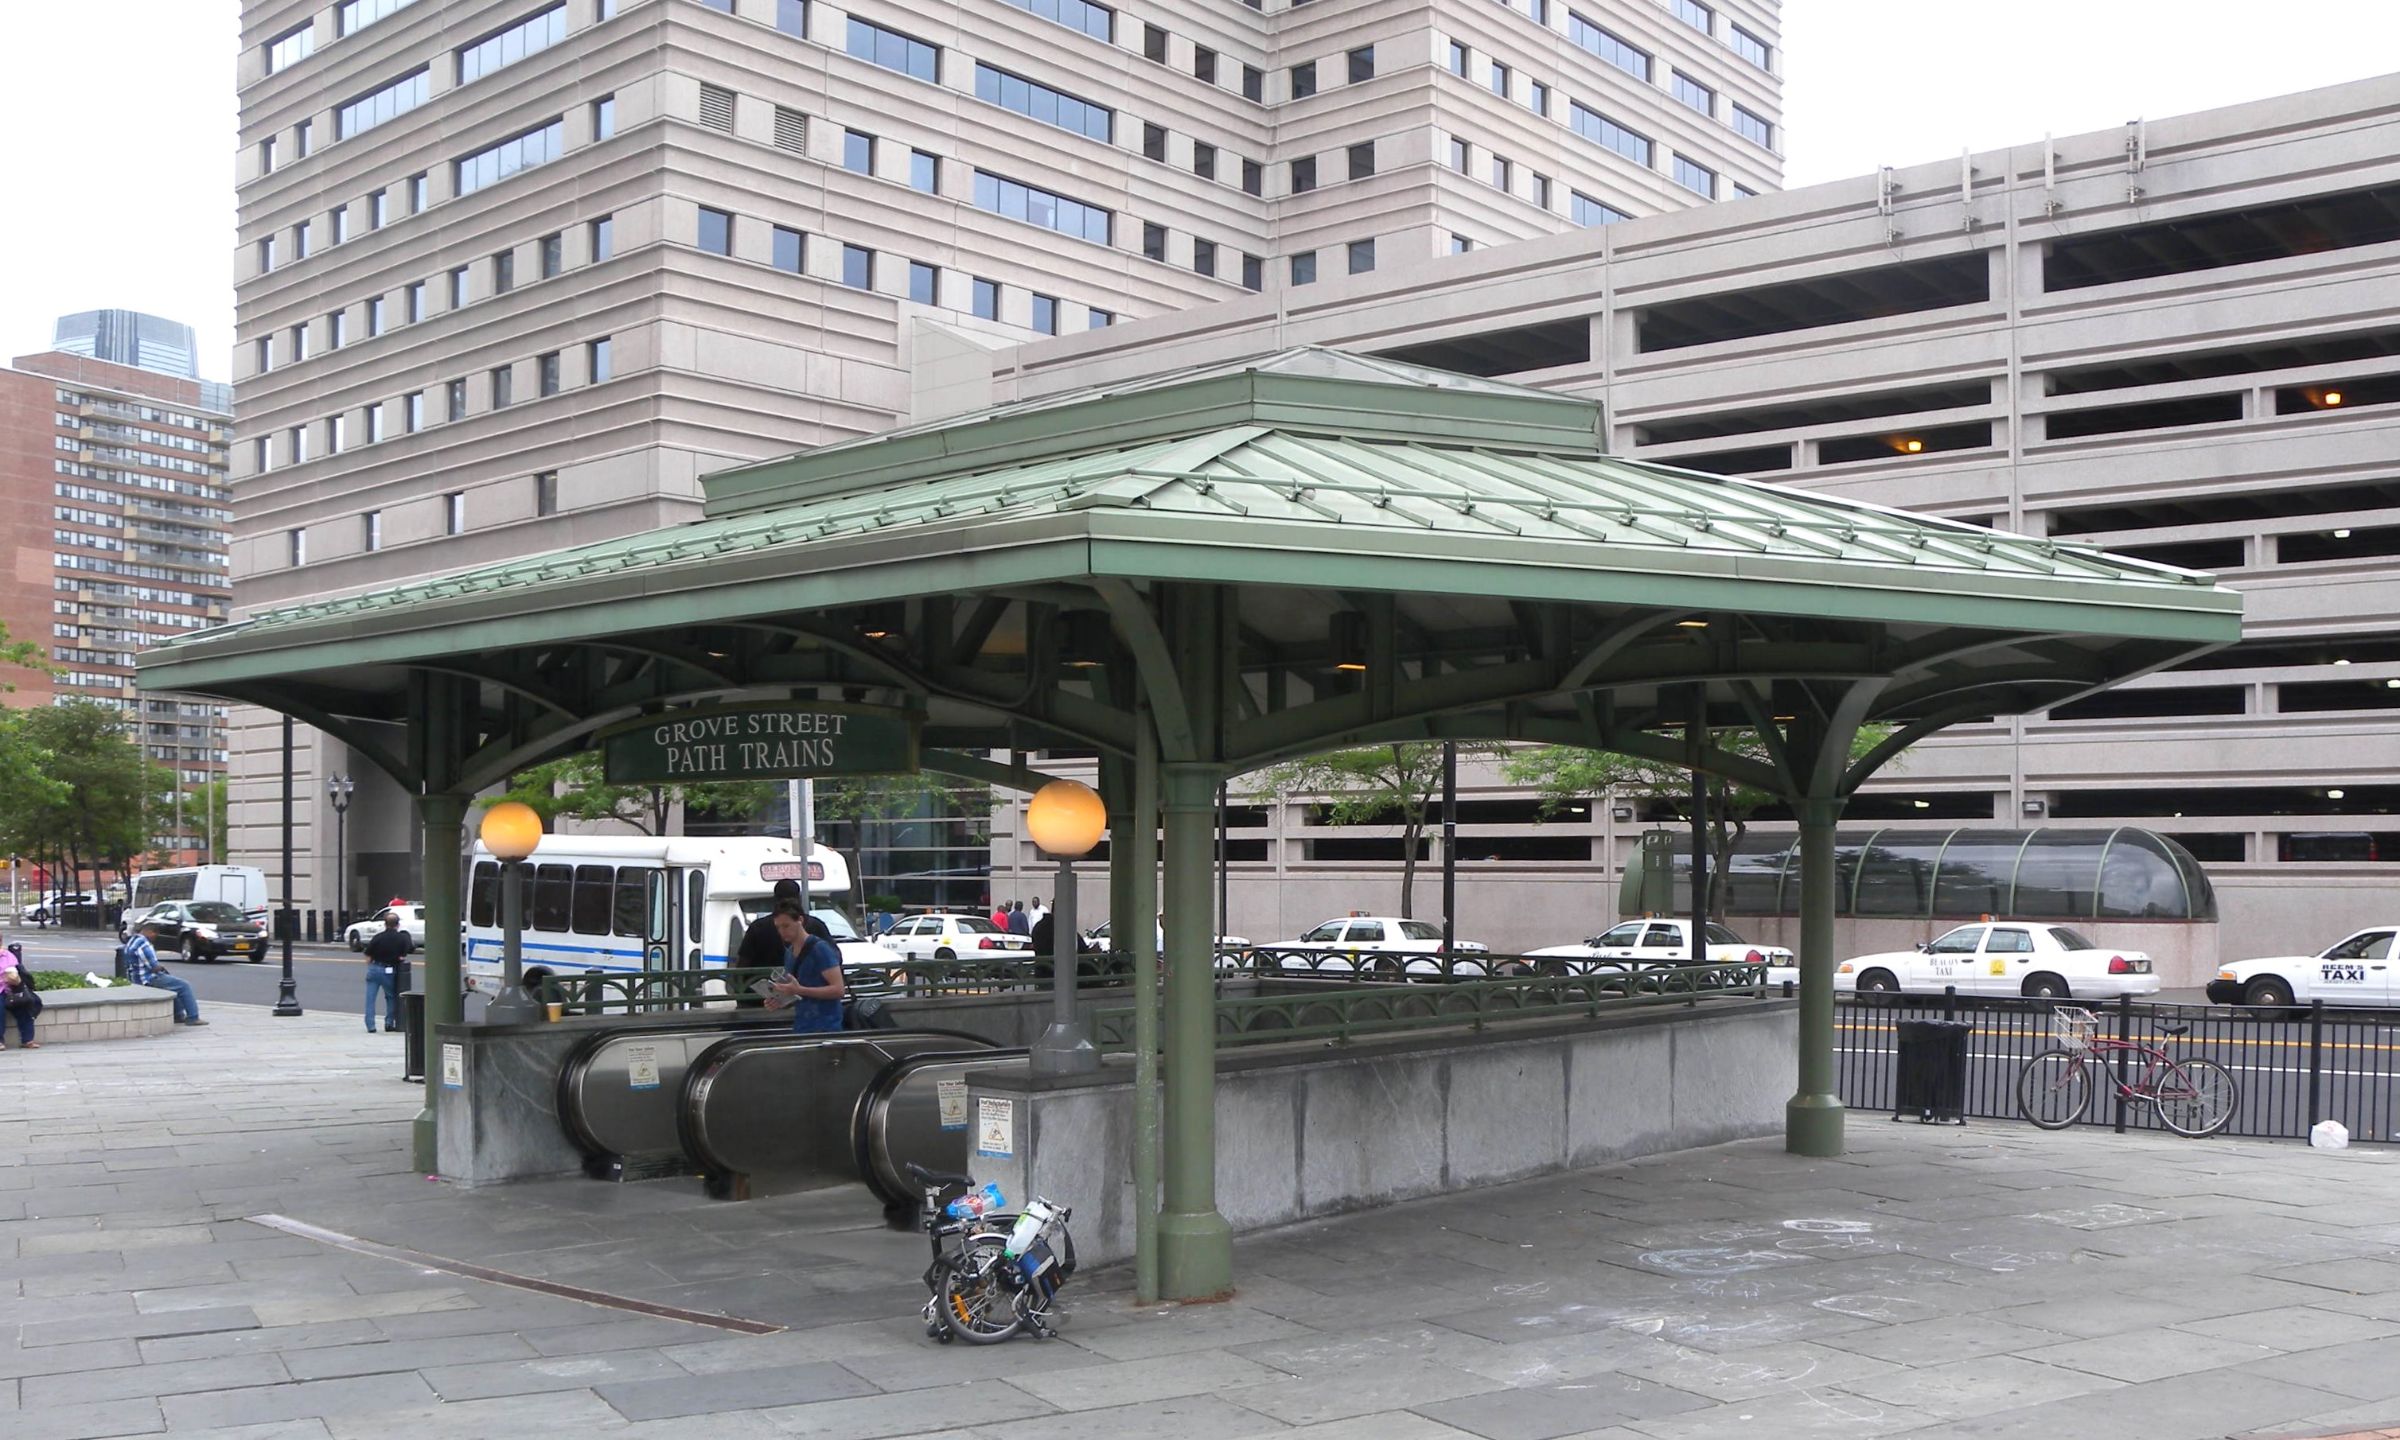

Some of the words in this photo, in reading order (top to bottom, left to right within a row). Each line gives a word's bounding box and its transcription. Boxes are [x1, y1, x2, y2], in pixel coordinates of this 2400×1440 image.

[654, 715, 739, 746] GROVE
[747, 713, 847, 735] STREET
[666, 744, 726, 774] PATH
[738, 738, 834, 770] TRAINS
[1936, 967, 1952, 976] TAXI
[2321, 969, 2364, 980] TAXI
